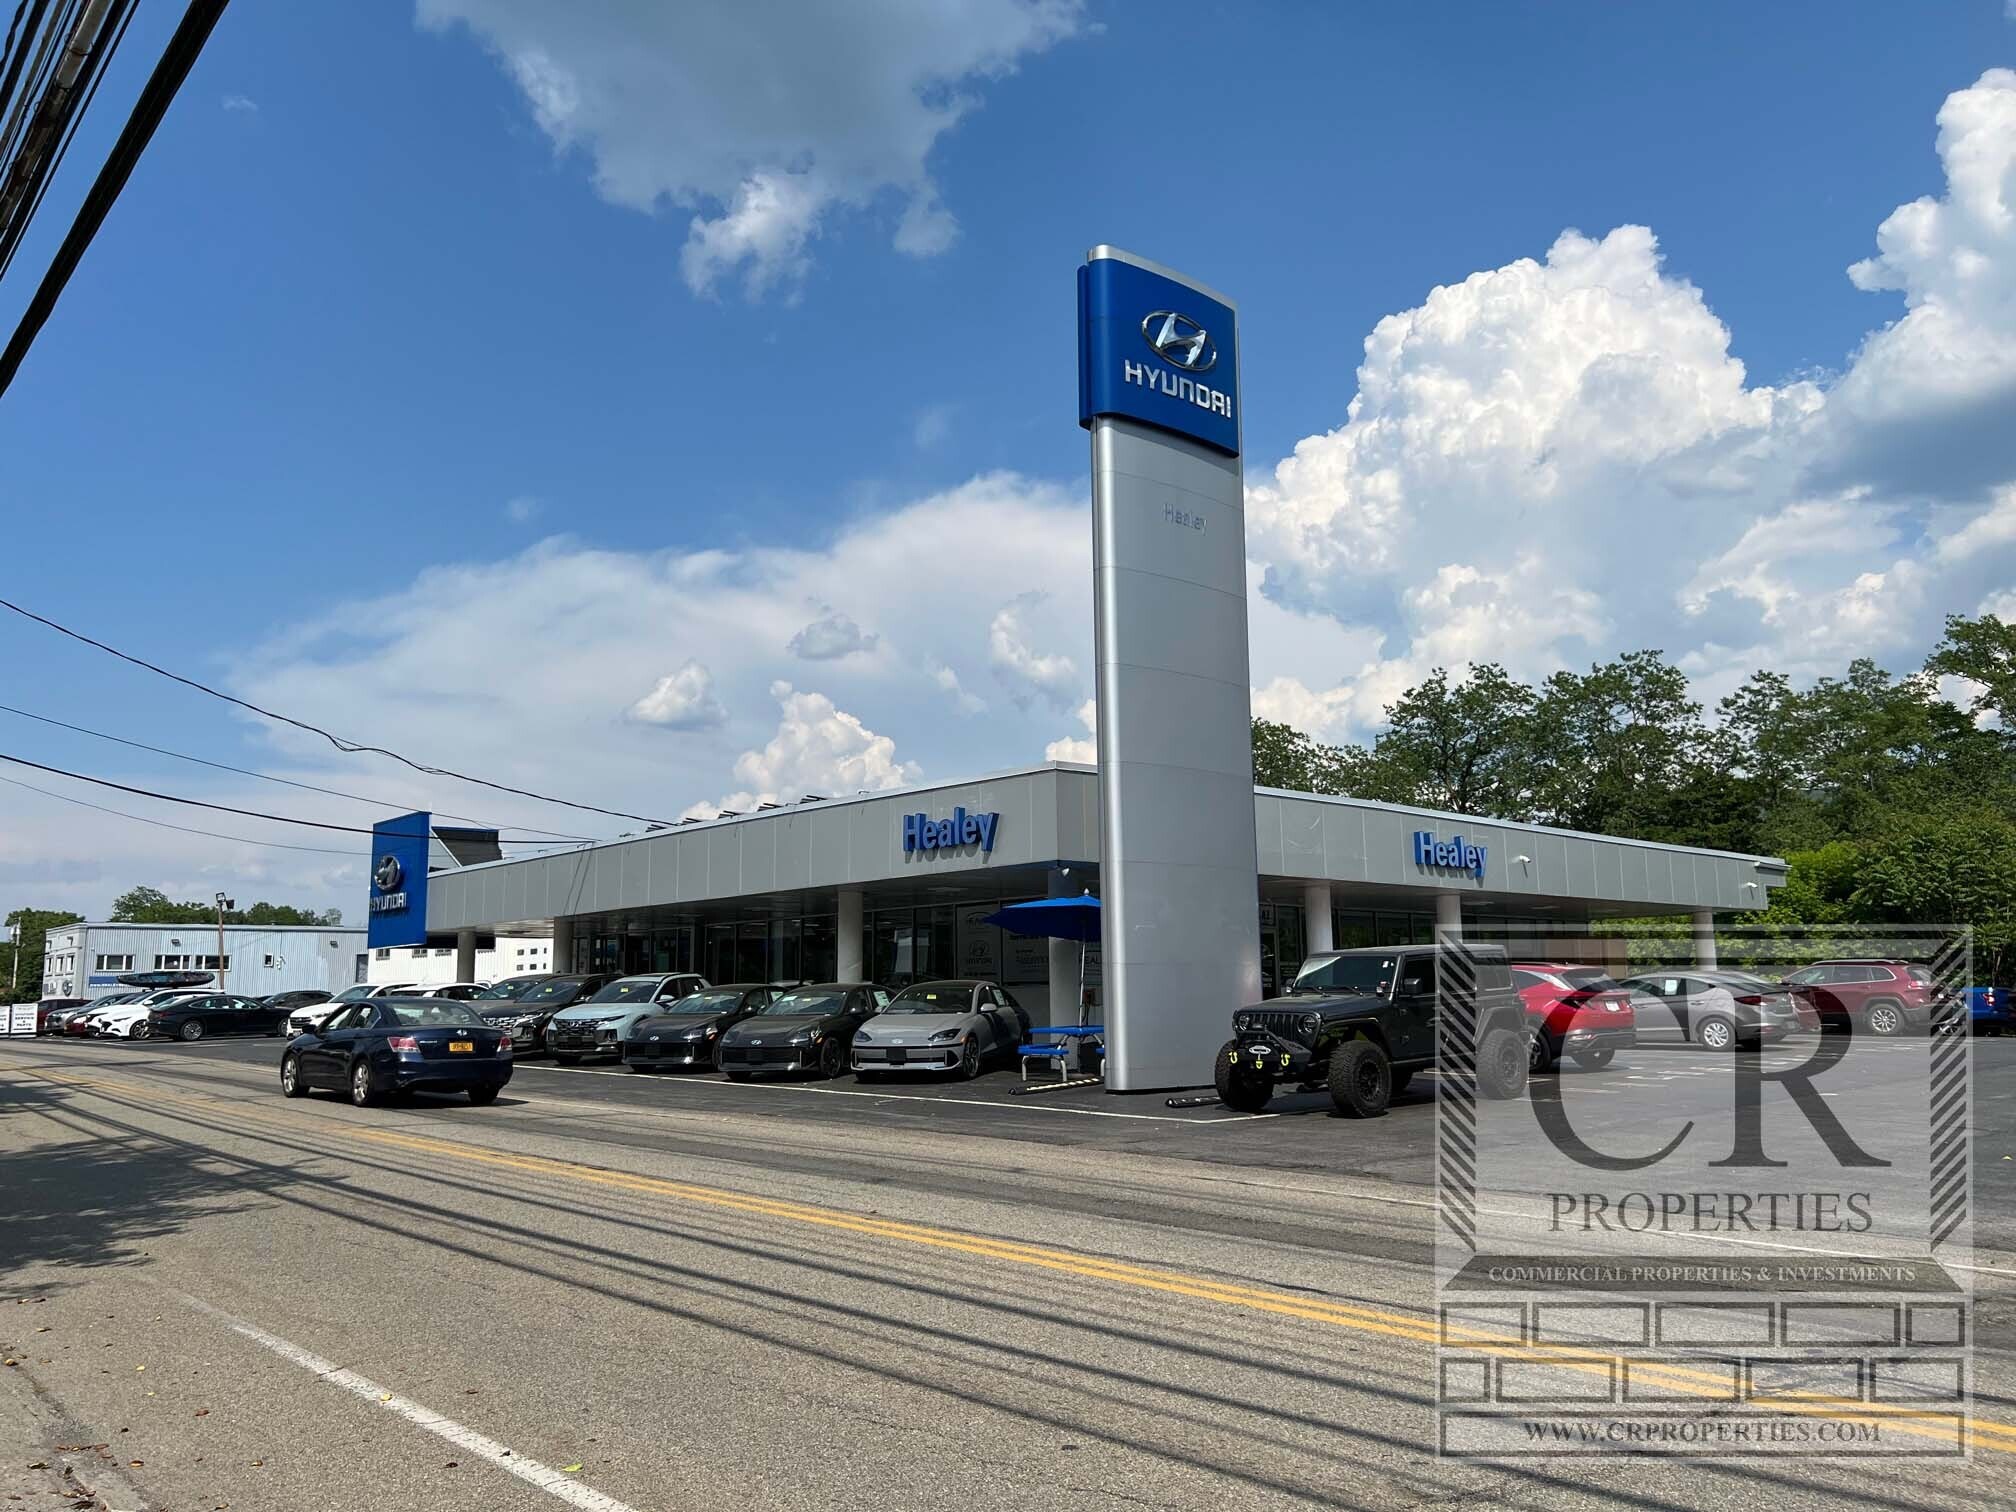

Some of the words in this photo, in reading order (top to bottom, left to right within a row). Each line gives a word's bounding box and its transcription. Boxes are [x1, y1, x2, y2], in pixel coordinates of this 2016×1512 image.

[1125, 359, 1231, 418] HYUNDAI
[903, 806, 1000, 852] Healey
[1412, 831, 1488, 878] Healey
[370, 892, 407, 912] HYUNDAI
